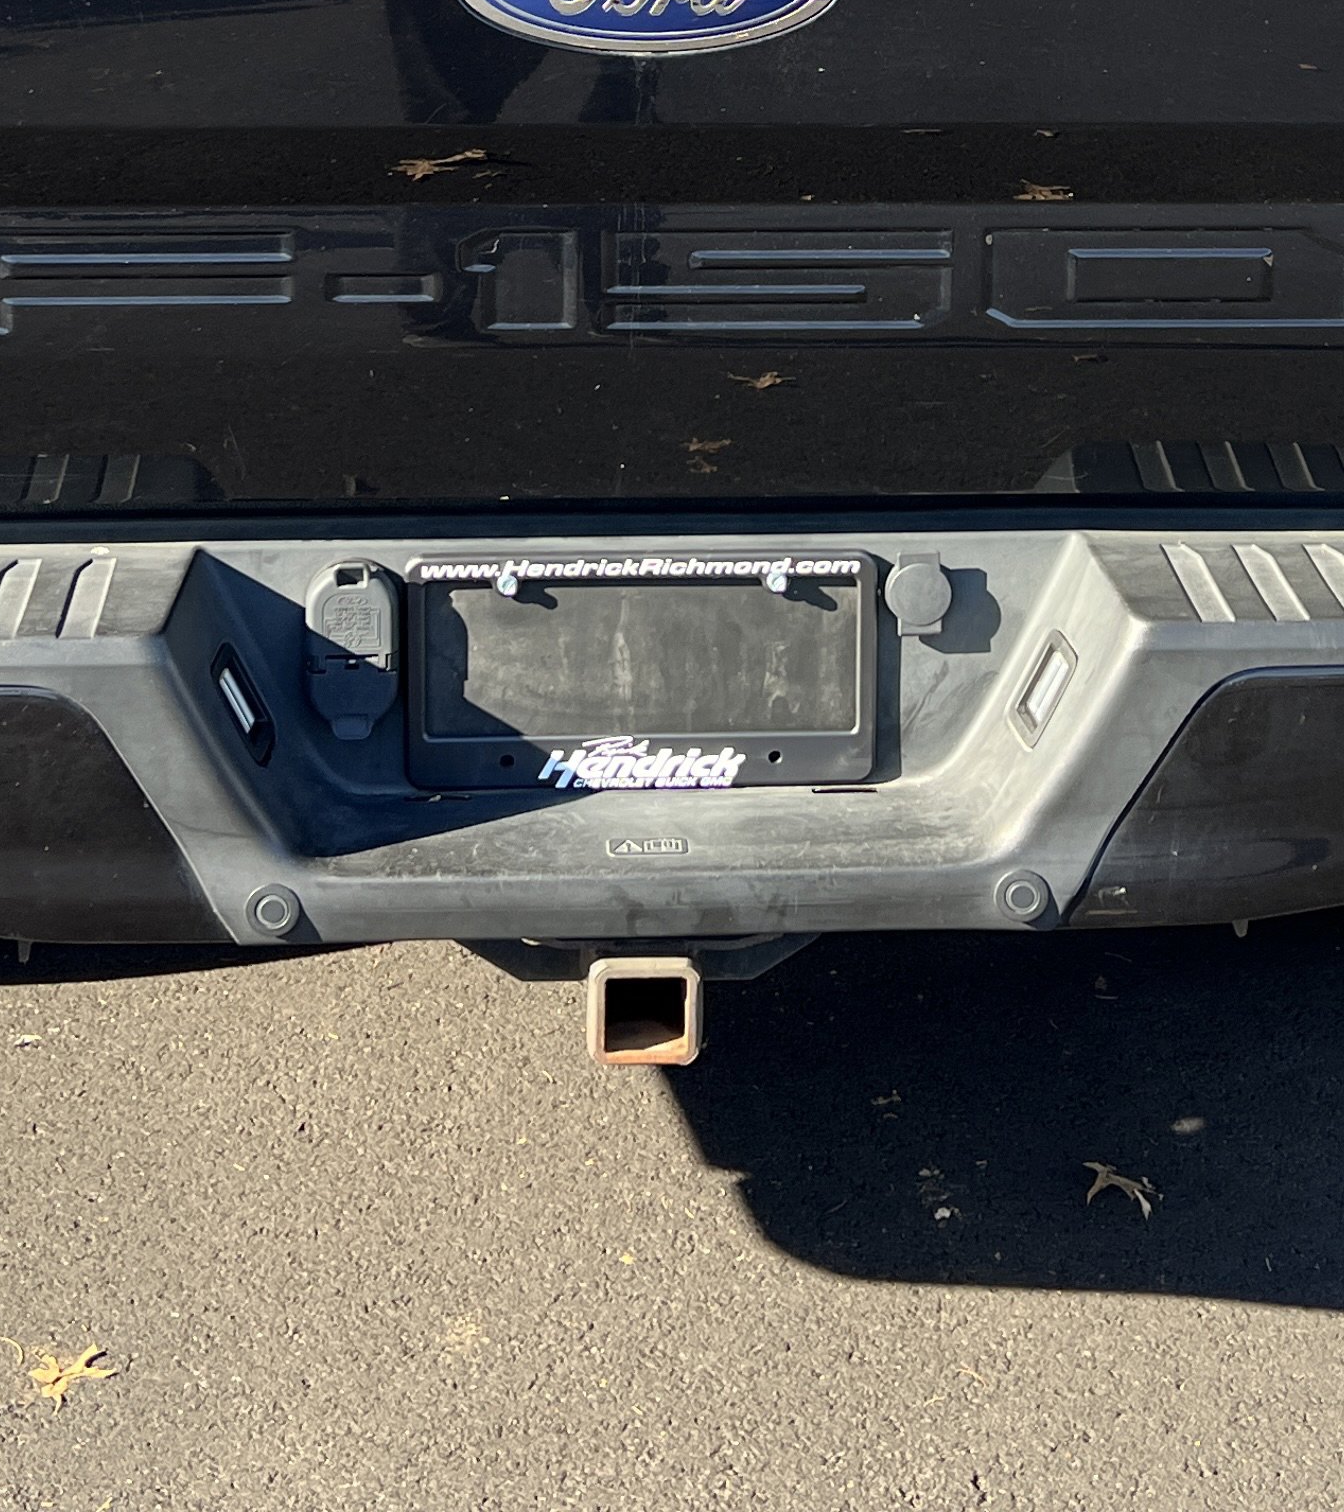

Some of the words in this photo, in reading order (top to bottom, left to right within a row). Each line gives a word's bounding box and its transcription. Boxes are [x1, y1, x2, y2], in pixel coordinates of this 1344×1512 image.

[420, 557, 862, 580] www.HendrickRichmond.com
[538, 747, 746, 788] Hendrick
[573, 777, 655, 788] CHEVROLET
[655, 777, 699, 788] BUICK
